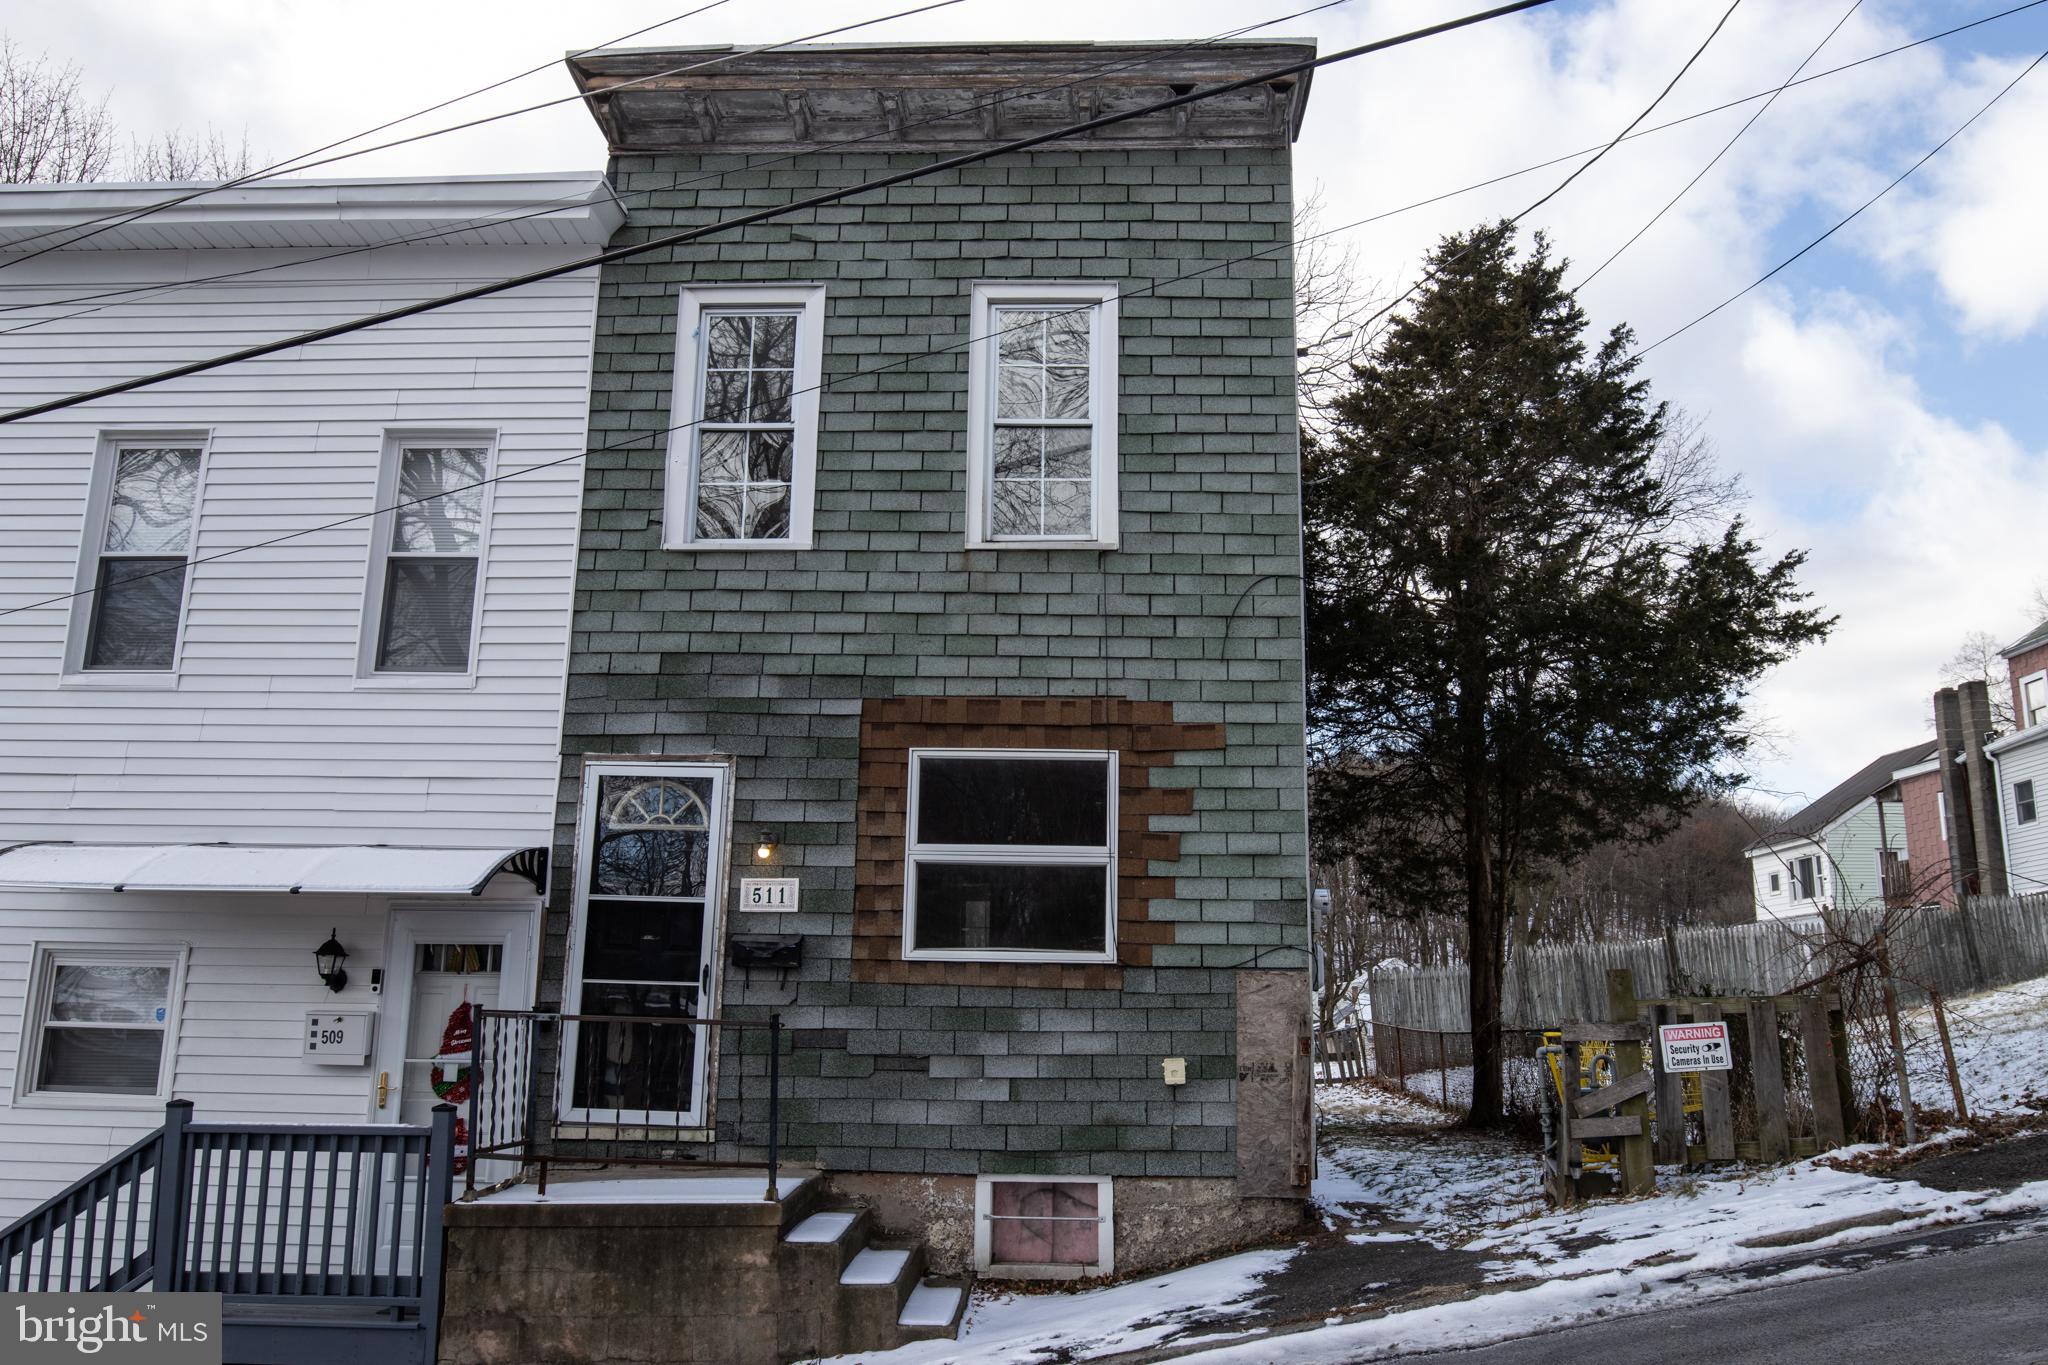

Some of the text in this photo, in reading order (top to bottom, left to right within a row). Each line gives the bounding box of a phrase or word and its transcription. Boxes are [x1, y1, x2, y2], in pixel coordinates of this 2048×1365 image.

[752, 887, 784, 903] 511
[321, 1030, 344, 1044] 509
[1666, 1026, 1721, 1040] WARNING
[1670, 1043, 1700, 1055] Security
[1671, 1054, 1724, 1067] Cameras In Use
